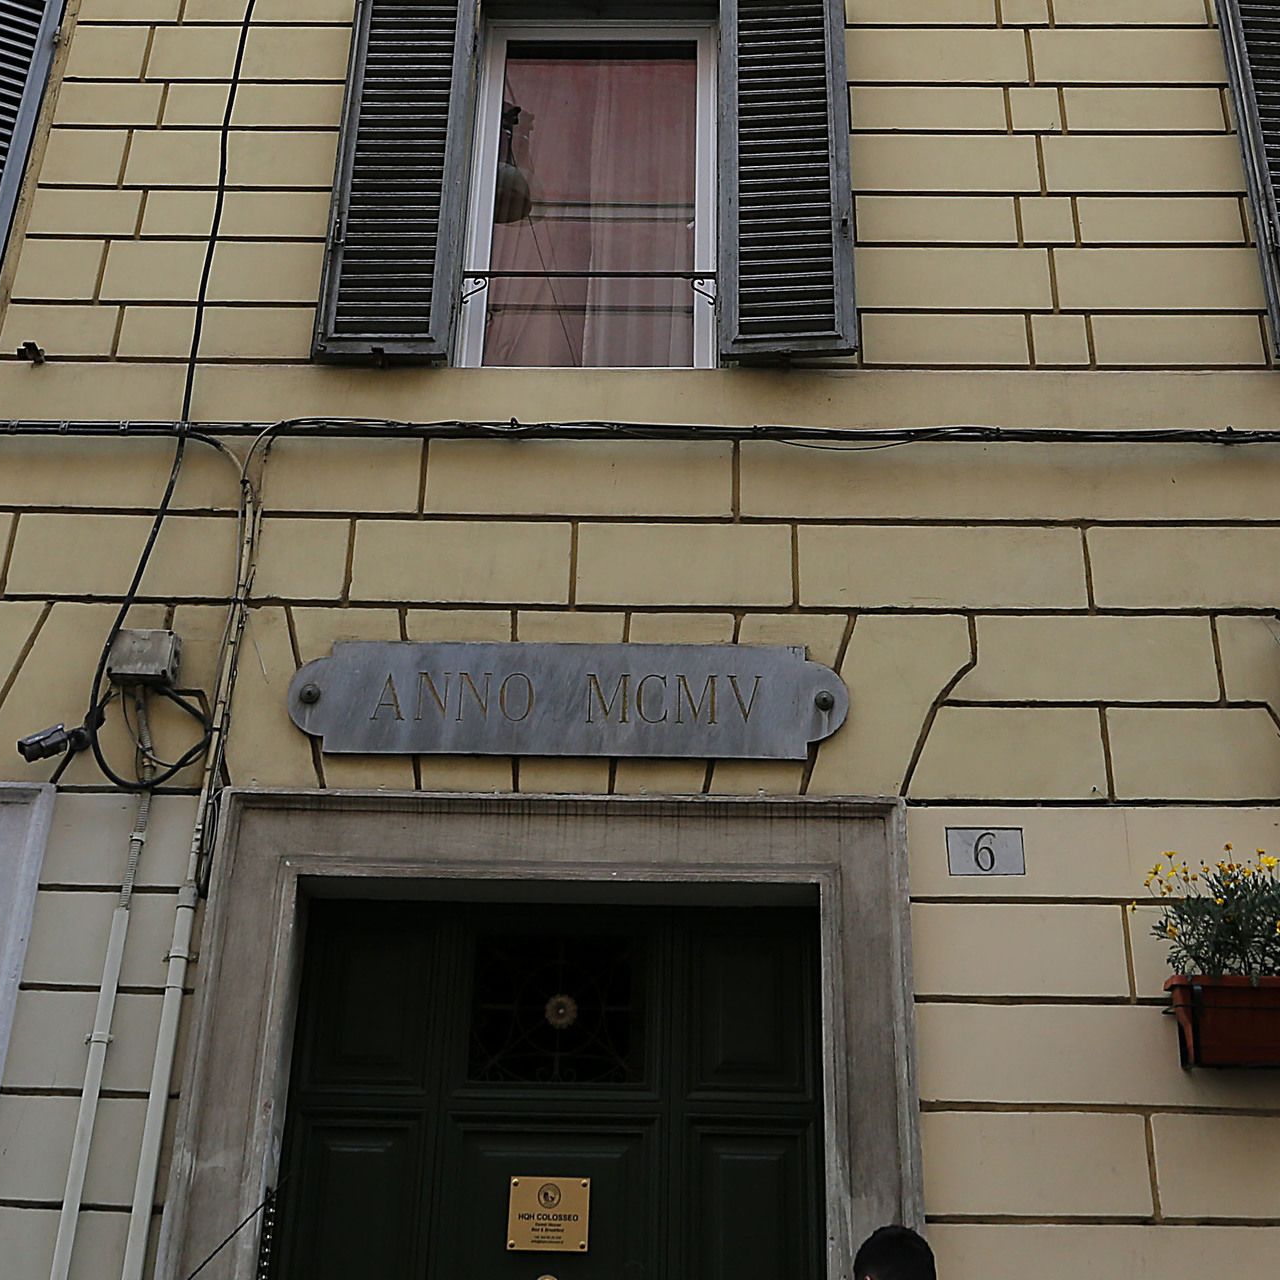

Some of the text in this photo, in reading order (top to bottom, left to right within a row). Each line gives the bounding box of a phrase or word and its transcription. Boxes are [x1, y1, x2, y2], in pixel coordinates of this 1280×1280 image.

[369, 671, 763, 725] ANNO MCMV
[972, 831, 997, 872] 6
[536, 1213, 579, 1222] COLOSSEO
